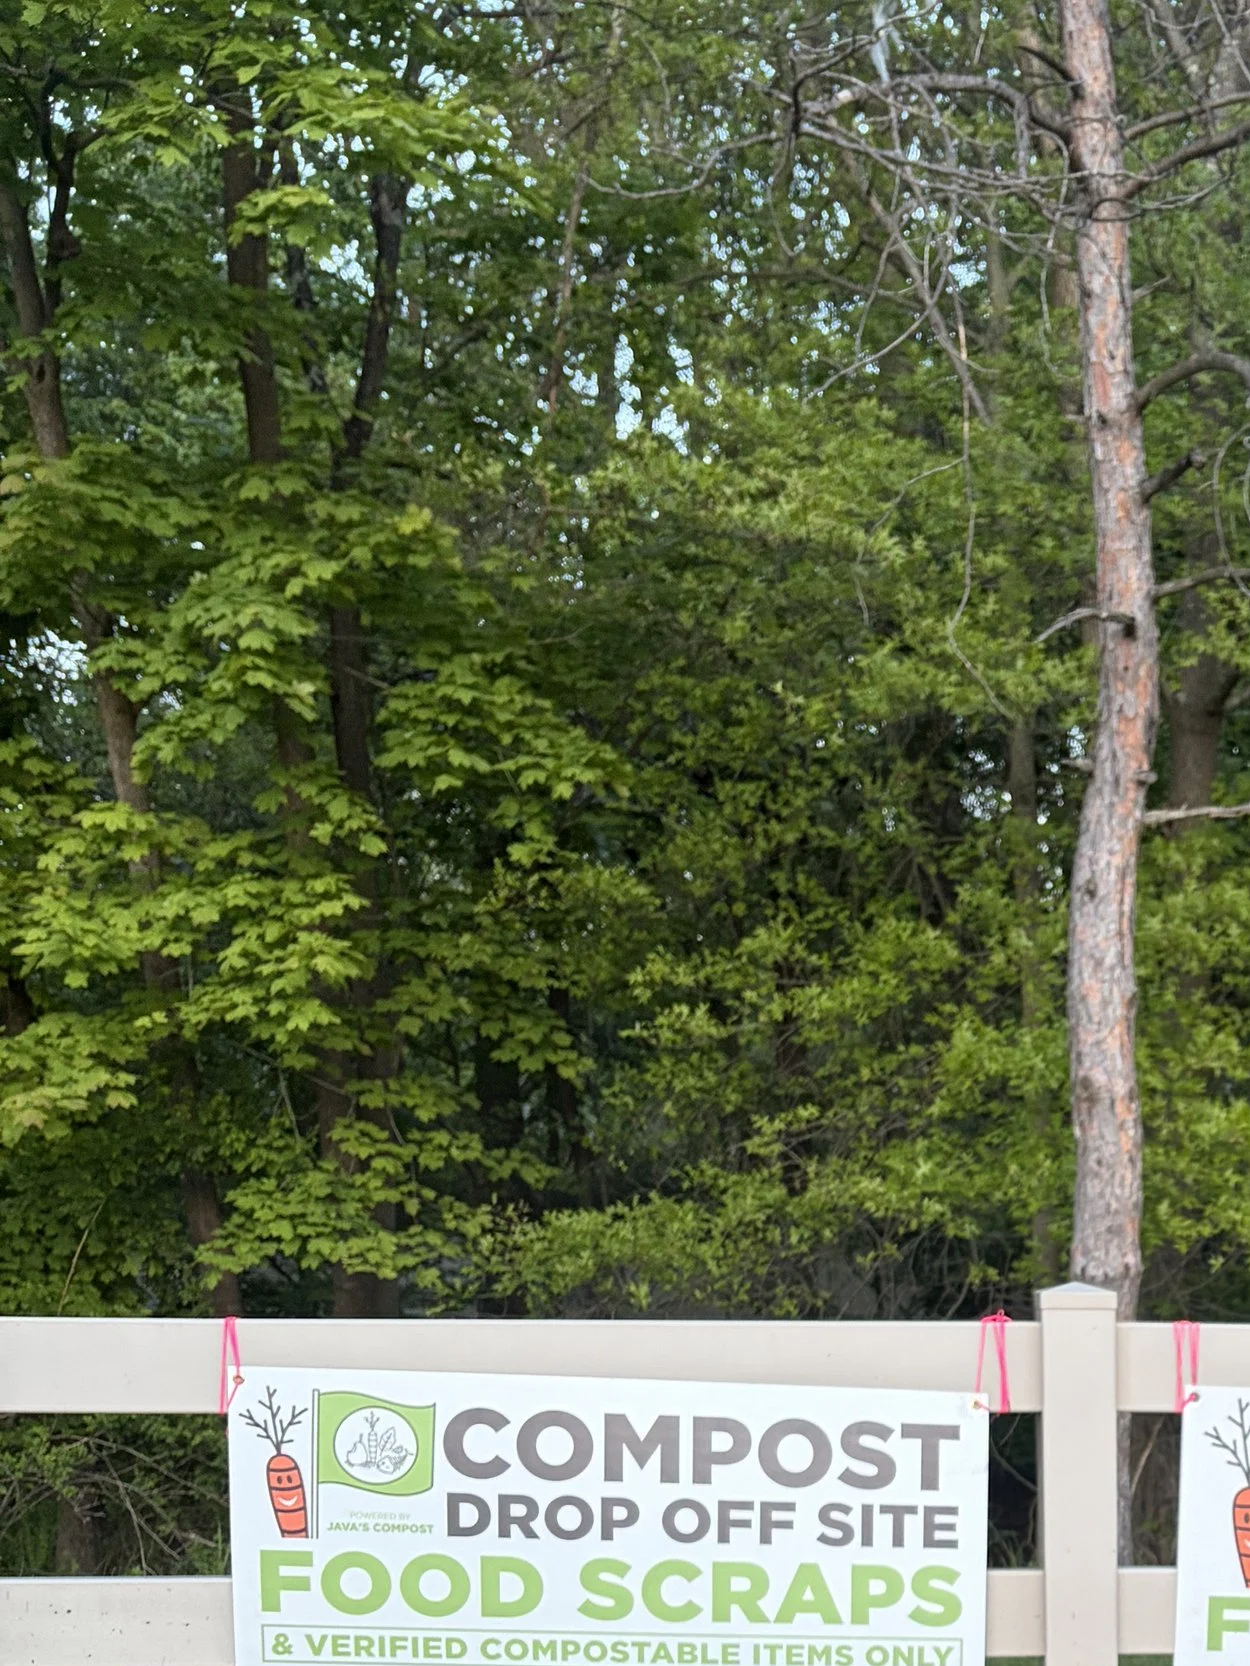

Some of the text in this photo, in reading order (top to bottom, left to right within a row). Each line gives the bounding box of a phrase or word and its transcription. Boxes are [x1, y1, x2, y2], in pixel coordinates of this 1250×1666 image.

[443, 1408, 960, 1490] COMPOST
[327, 1522, 433, 1533] JAVA'S COMPOST
[349, 1511, 412, 1521] POWERED BY
[447, 1493, 959, 1549] DROP OFF SITE
[260, 1550, 962, 1627] FOOD SCRAPS
[272, 1633, 293, 1655] &
[305, 1634, 467, 1659] VERIFIED
[480, 1639, 740, 1665] COMPOSTABLE
[753, 1644, 853, 1666] ITEMS
